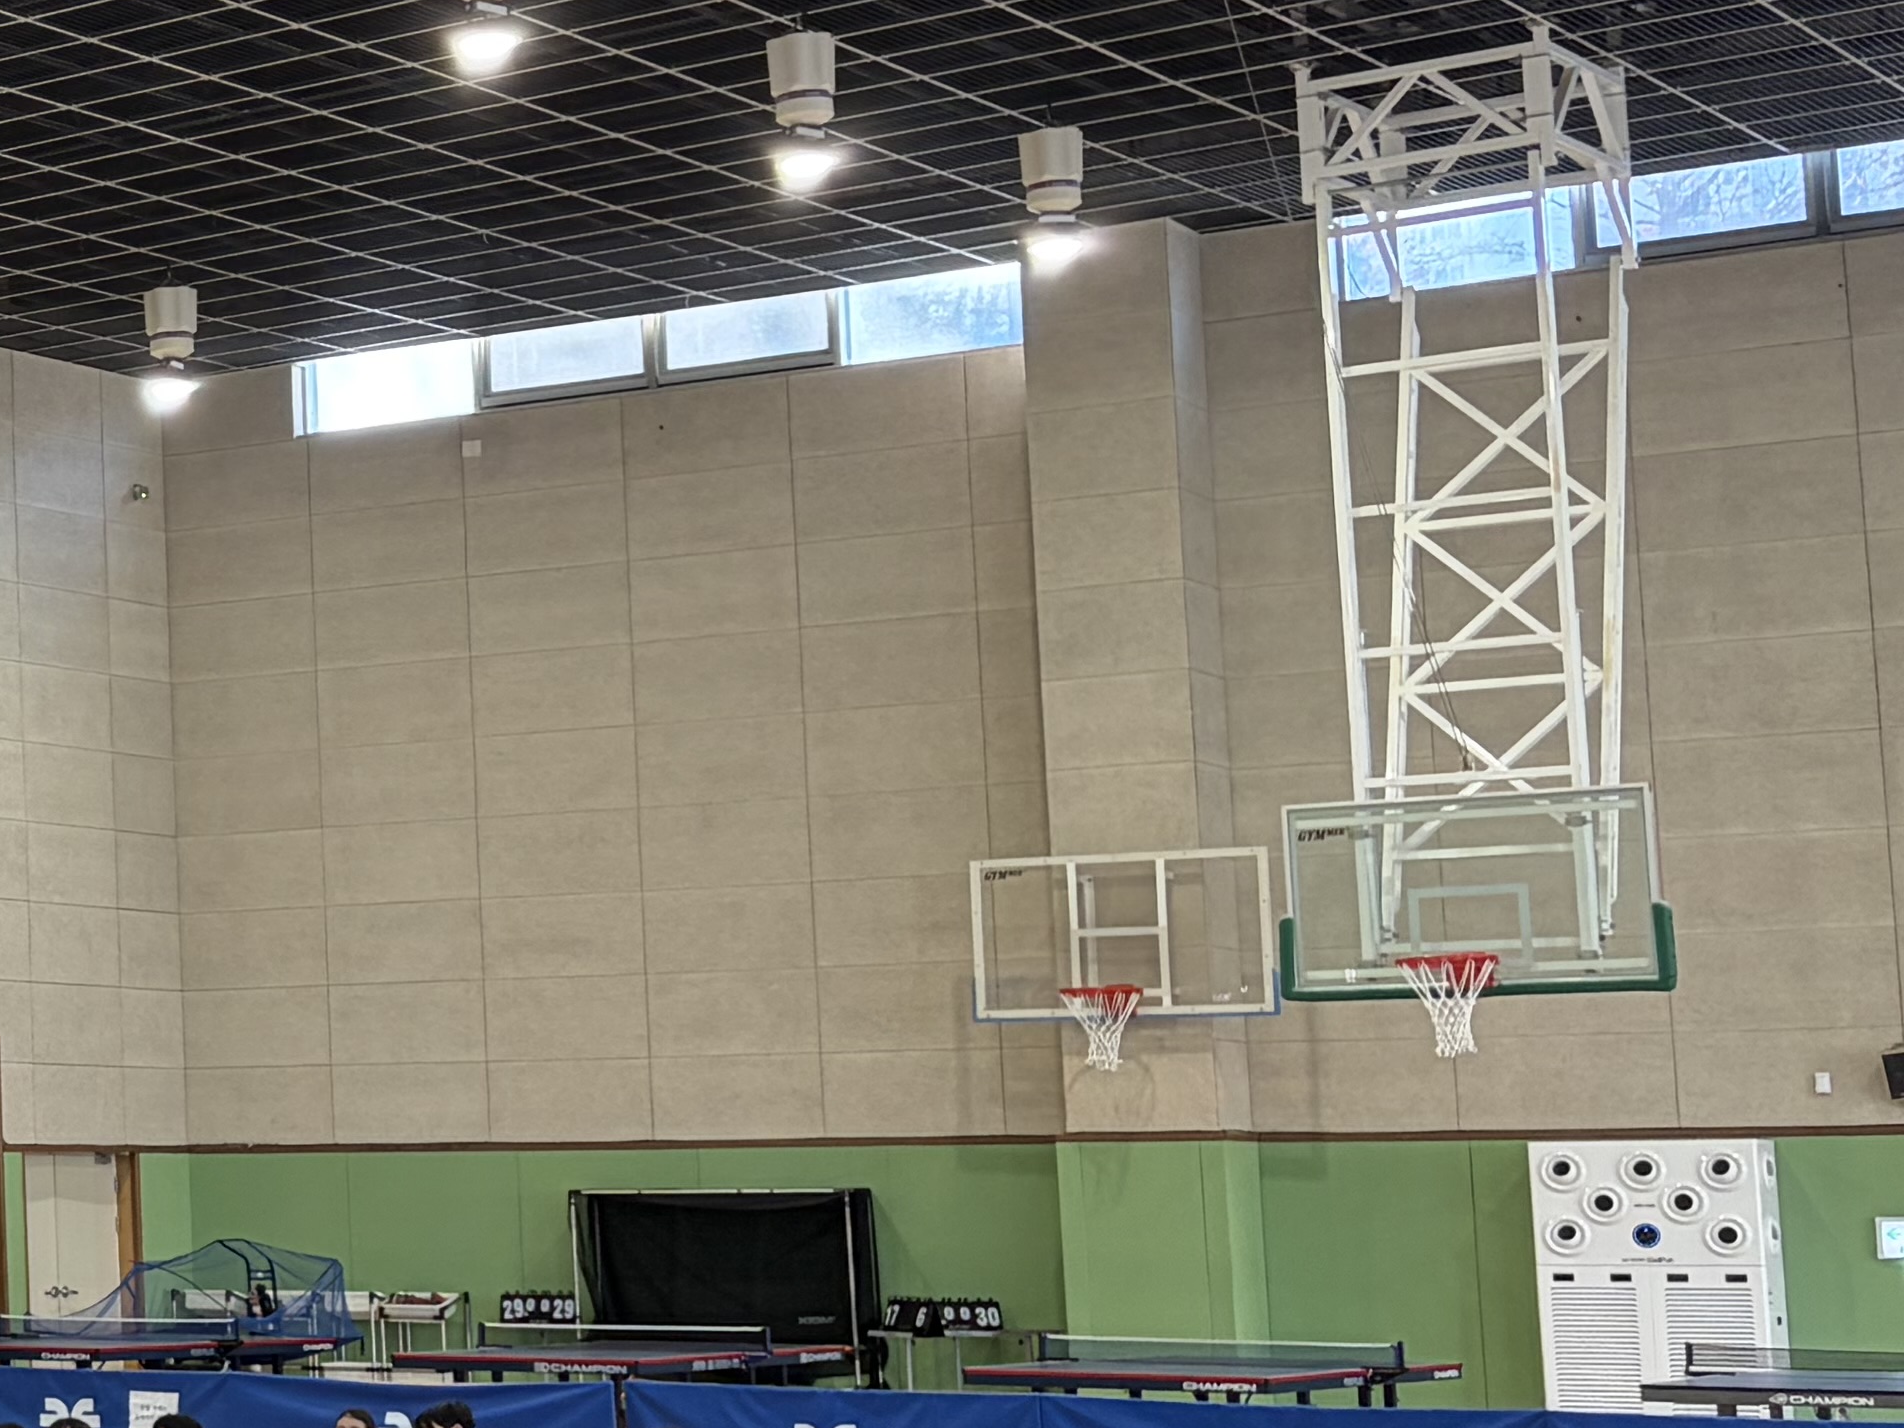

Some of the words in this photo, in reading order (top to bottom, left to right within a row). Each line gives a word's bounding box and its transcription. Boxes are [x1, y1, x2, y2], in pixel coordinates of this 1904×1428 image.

[549, 1363, 628, 1374] CHAMPION
[1182, 1382, 1257, 1393] CHAMPION
[1789, 1394, 1875, 1407] CHAMPION
